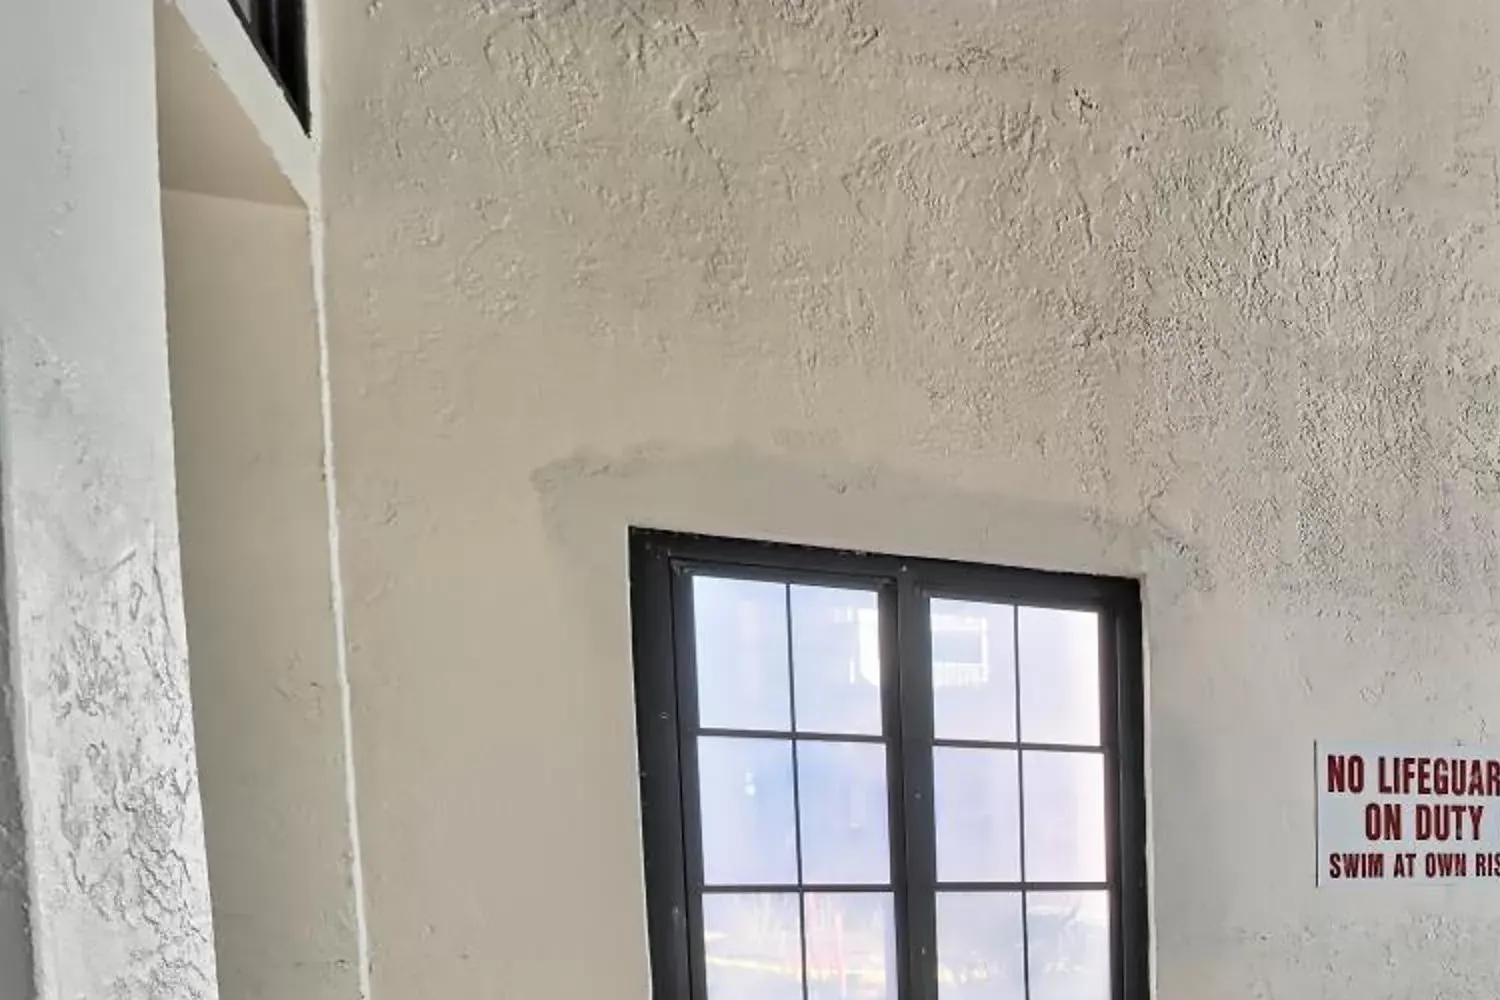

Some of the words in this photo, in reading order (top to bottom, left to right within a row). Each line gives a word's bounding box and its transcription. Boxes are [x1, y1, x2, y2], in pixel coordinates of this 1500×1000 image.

[1327, 755, 1365, 793] NO
[1365, 803, 1402, 841] ON
[1416, 804, 1484, 841] DUTY
[1329, 853, 1384, 878] SWIM
[1393, 853, 1417, 878] AT
[1425, 853, 1467, 878] OWN
